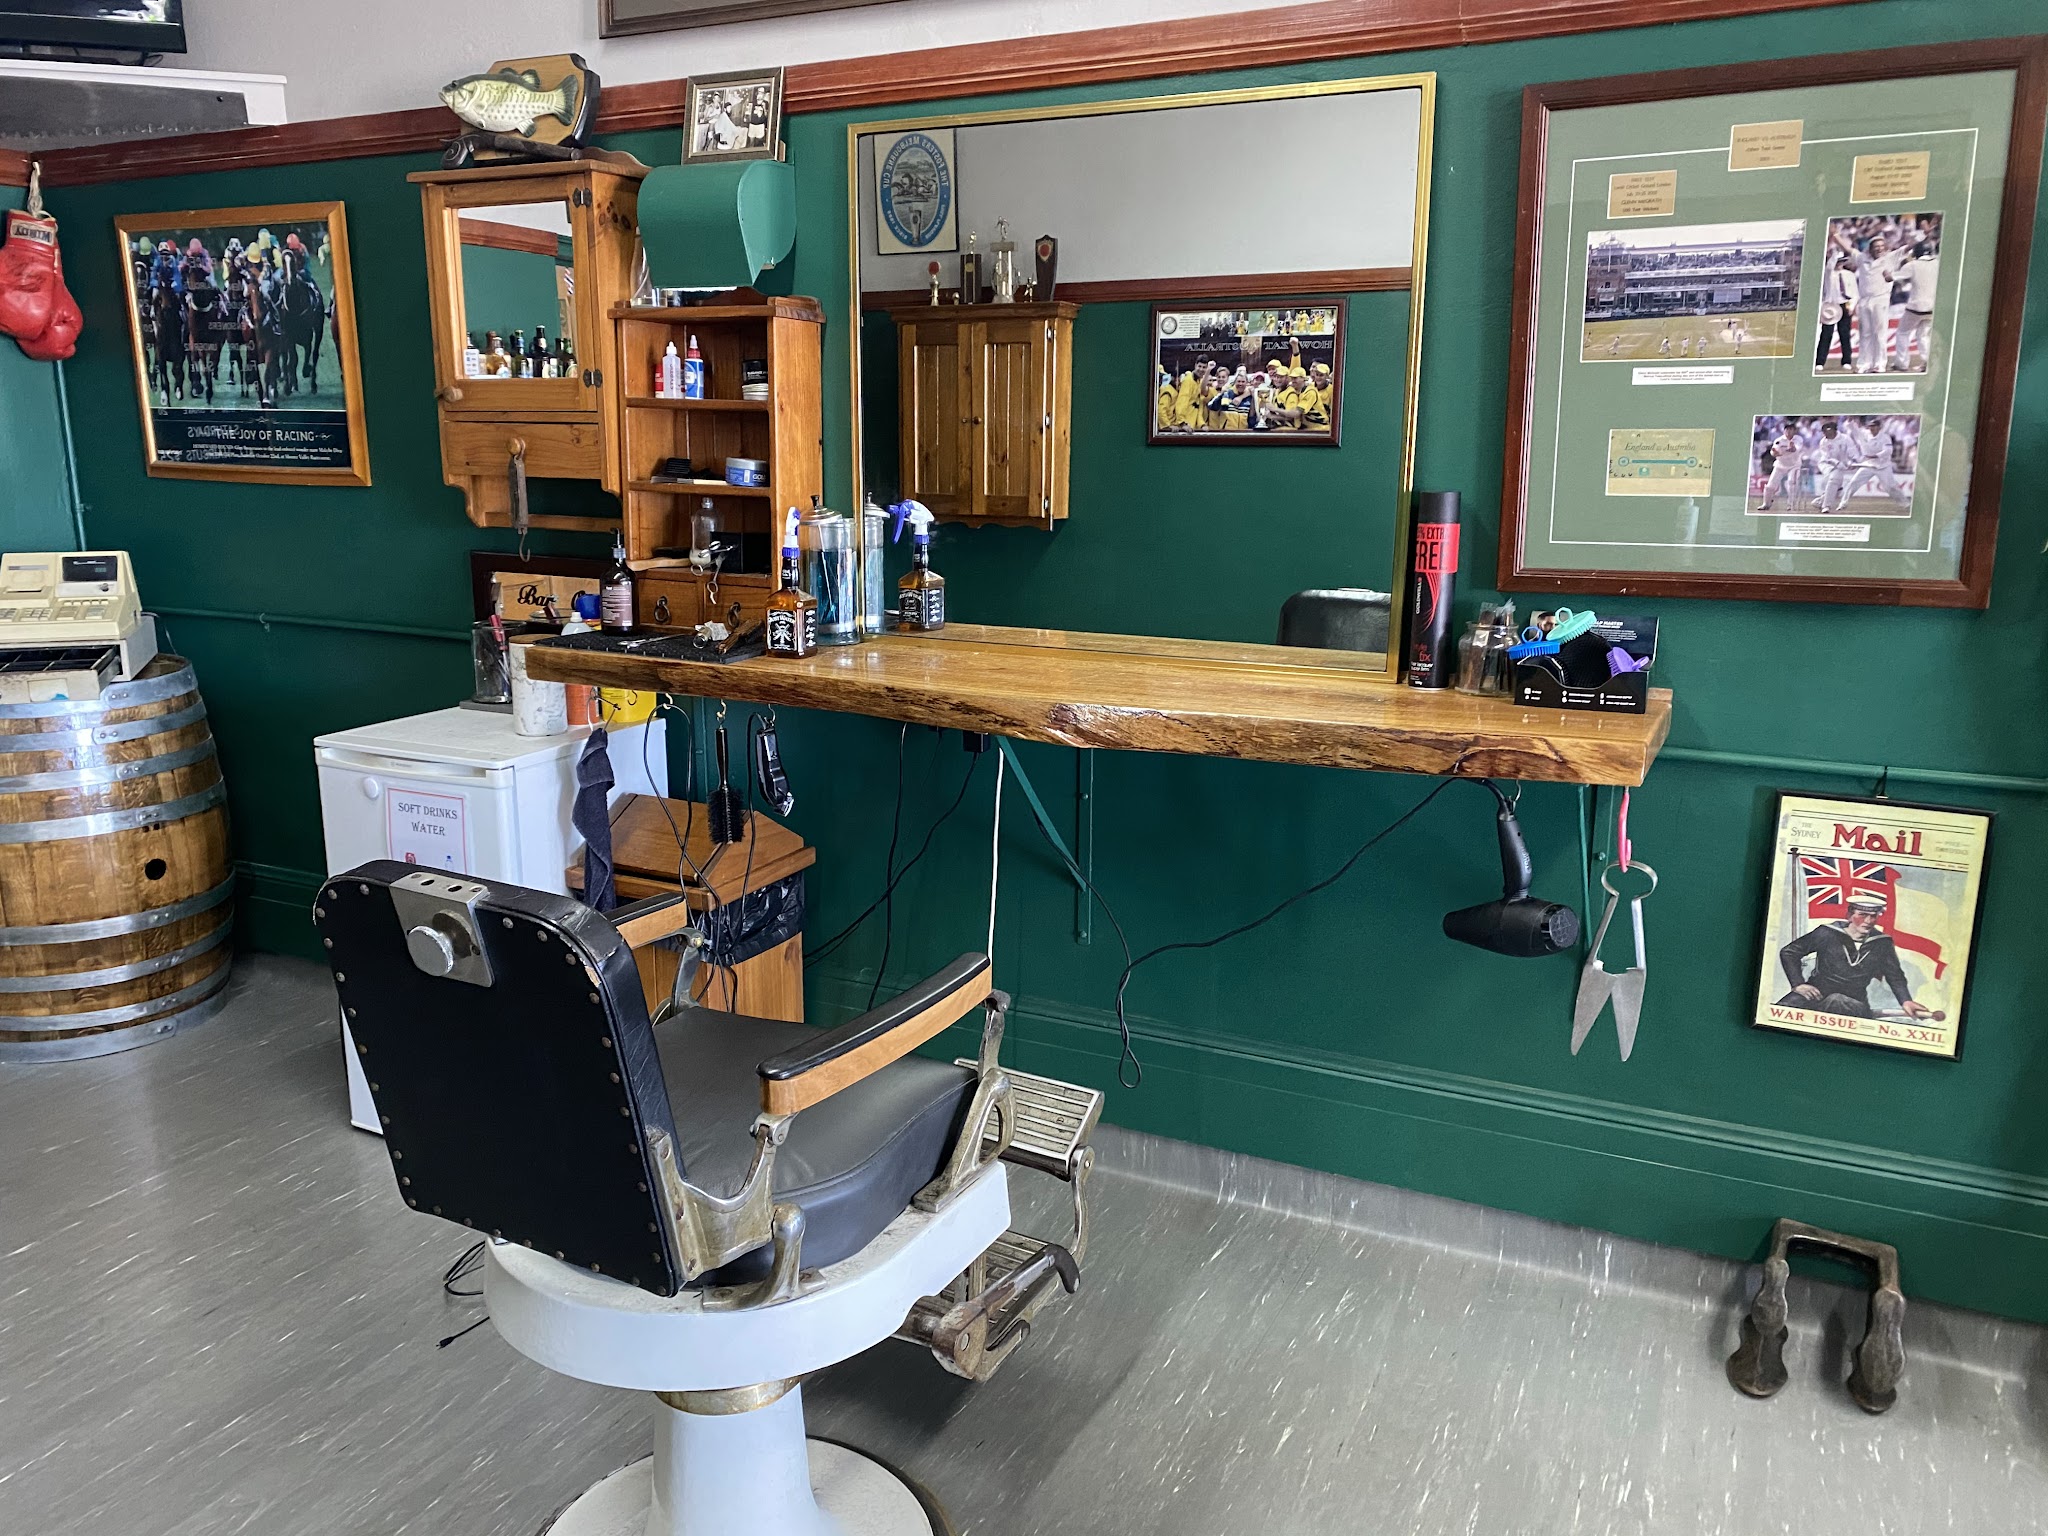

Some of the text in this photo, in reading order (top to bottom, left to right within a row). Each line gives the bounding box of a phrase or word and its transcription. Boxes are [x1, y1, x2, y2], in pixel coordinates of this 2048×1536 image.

[216, 428, 315, 441] THE JOY OF RACING
[517, 584, 555, 607] Bar
[398, 802, 458, 819] SOFT DRINKS
[411, 821, 446, 836] WATER
[1791, 823, 1923, 856] SYDNEY Mail
[1770, 1007, 1805, 1022] WAR
[1813, 1015, 1857, 1030] ISSUE
